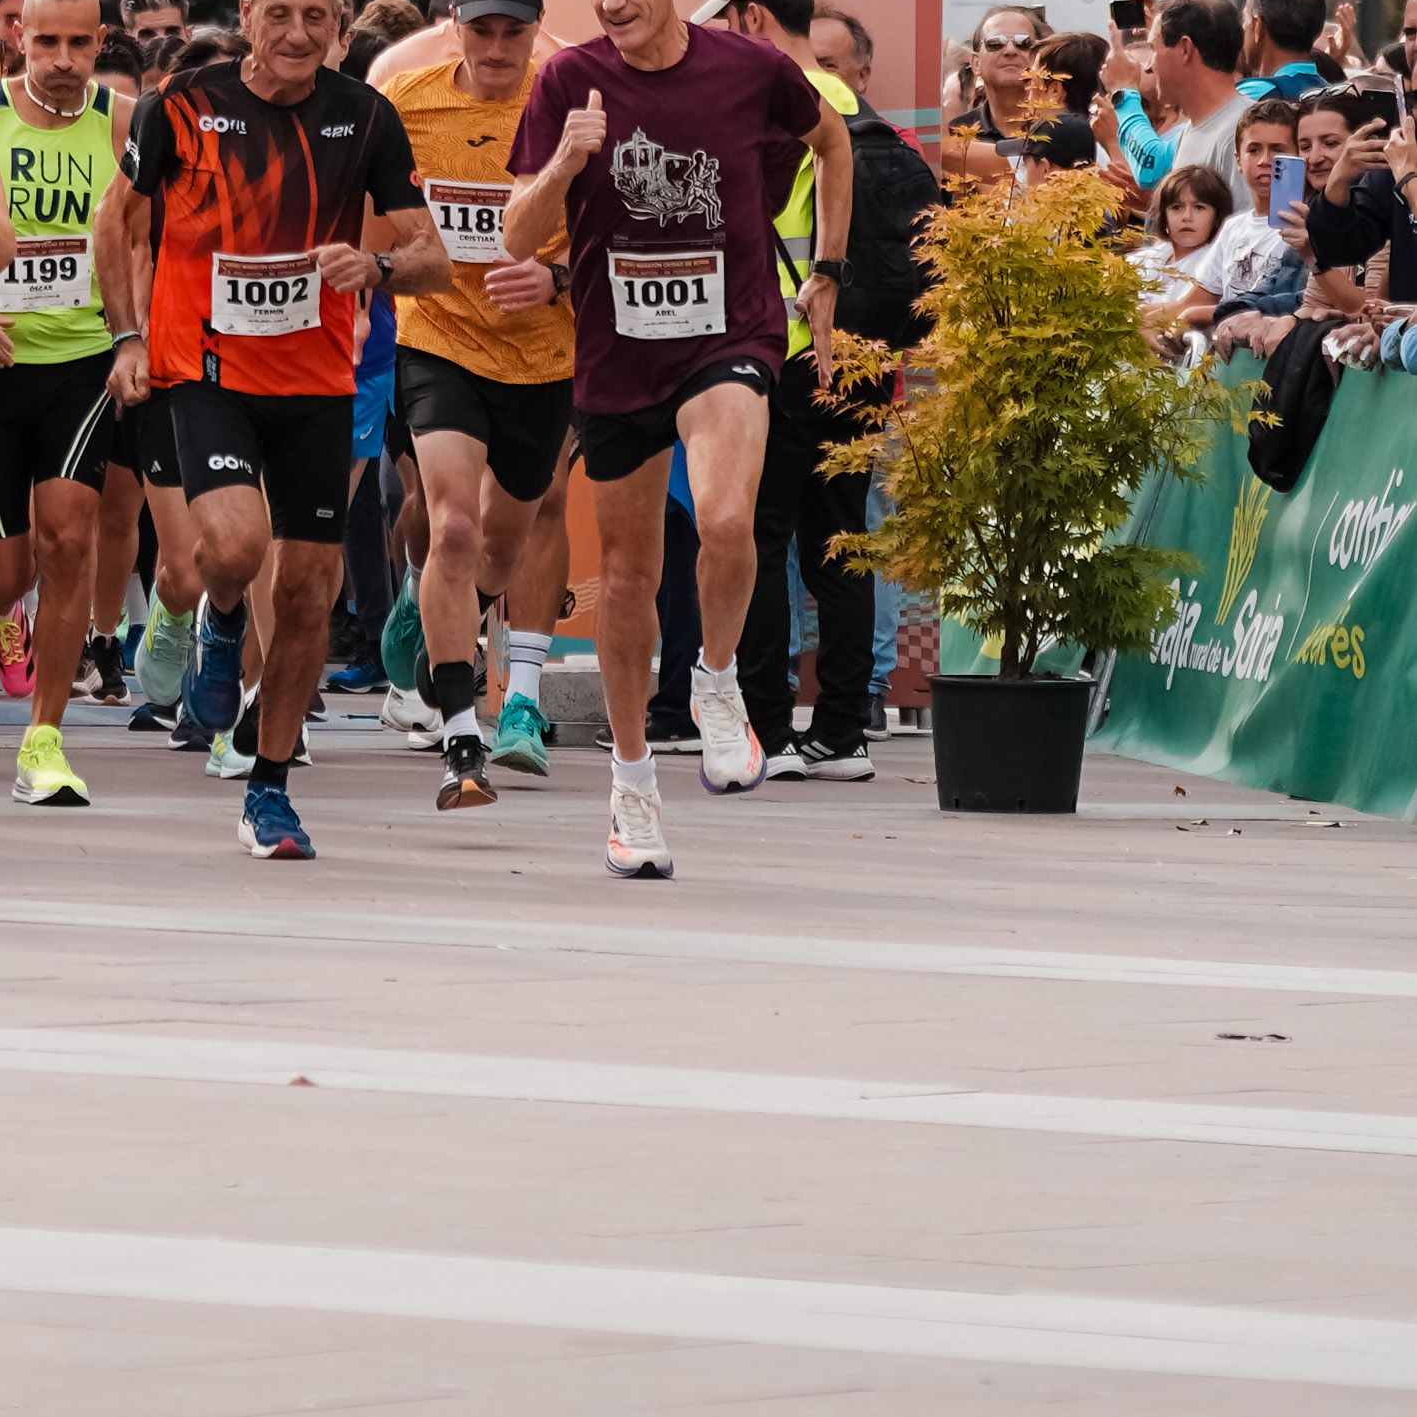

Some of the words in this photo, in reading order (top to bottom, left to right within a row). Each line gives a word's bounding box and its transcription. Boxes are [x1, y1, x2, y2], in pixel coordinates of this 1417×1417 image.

[199, 116, 247, 134] GOfit
[11, 147, 92, 188] RUN
[9, 187, 91, 224] RUN
[4, 256, 77, 284] 1199
[227, 277, 309, 307] 1002
[624, 277, 709, 308] 1001
[1221, 589, 1284, 682] Soria
